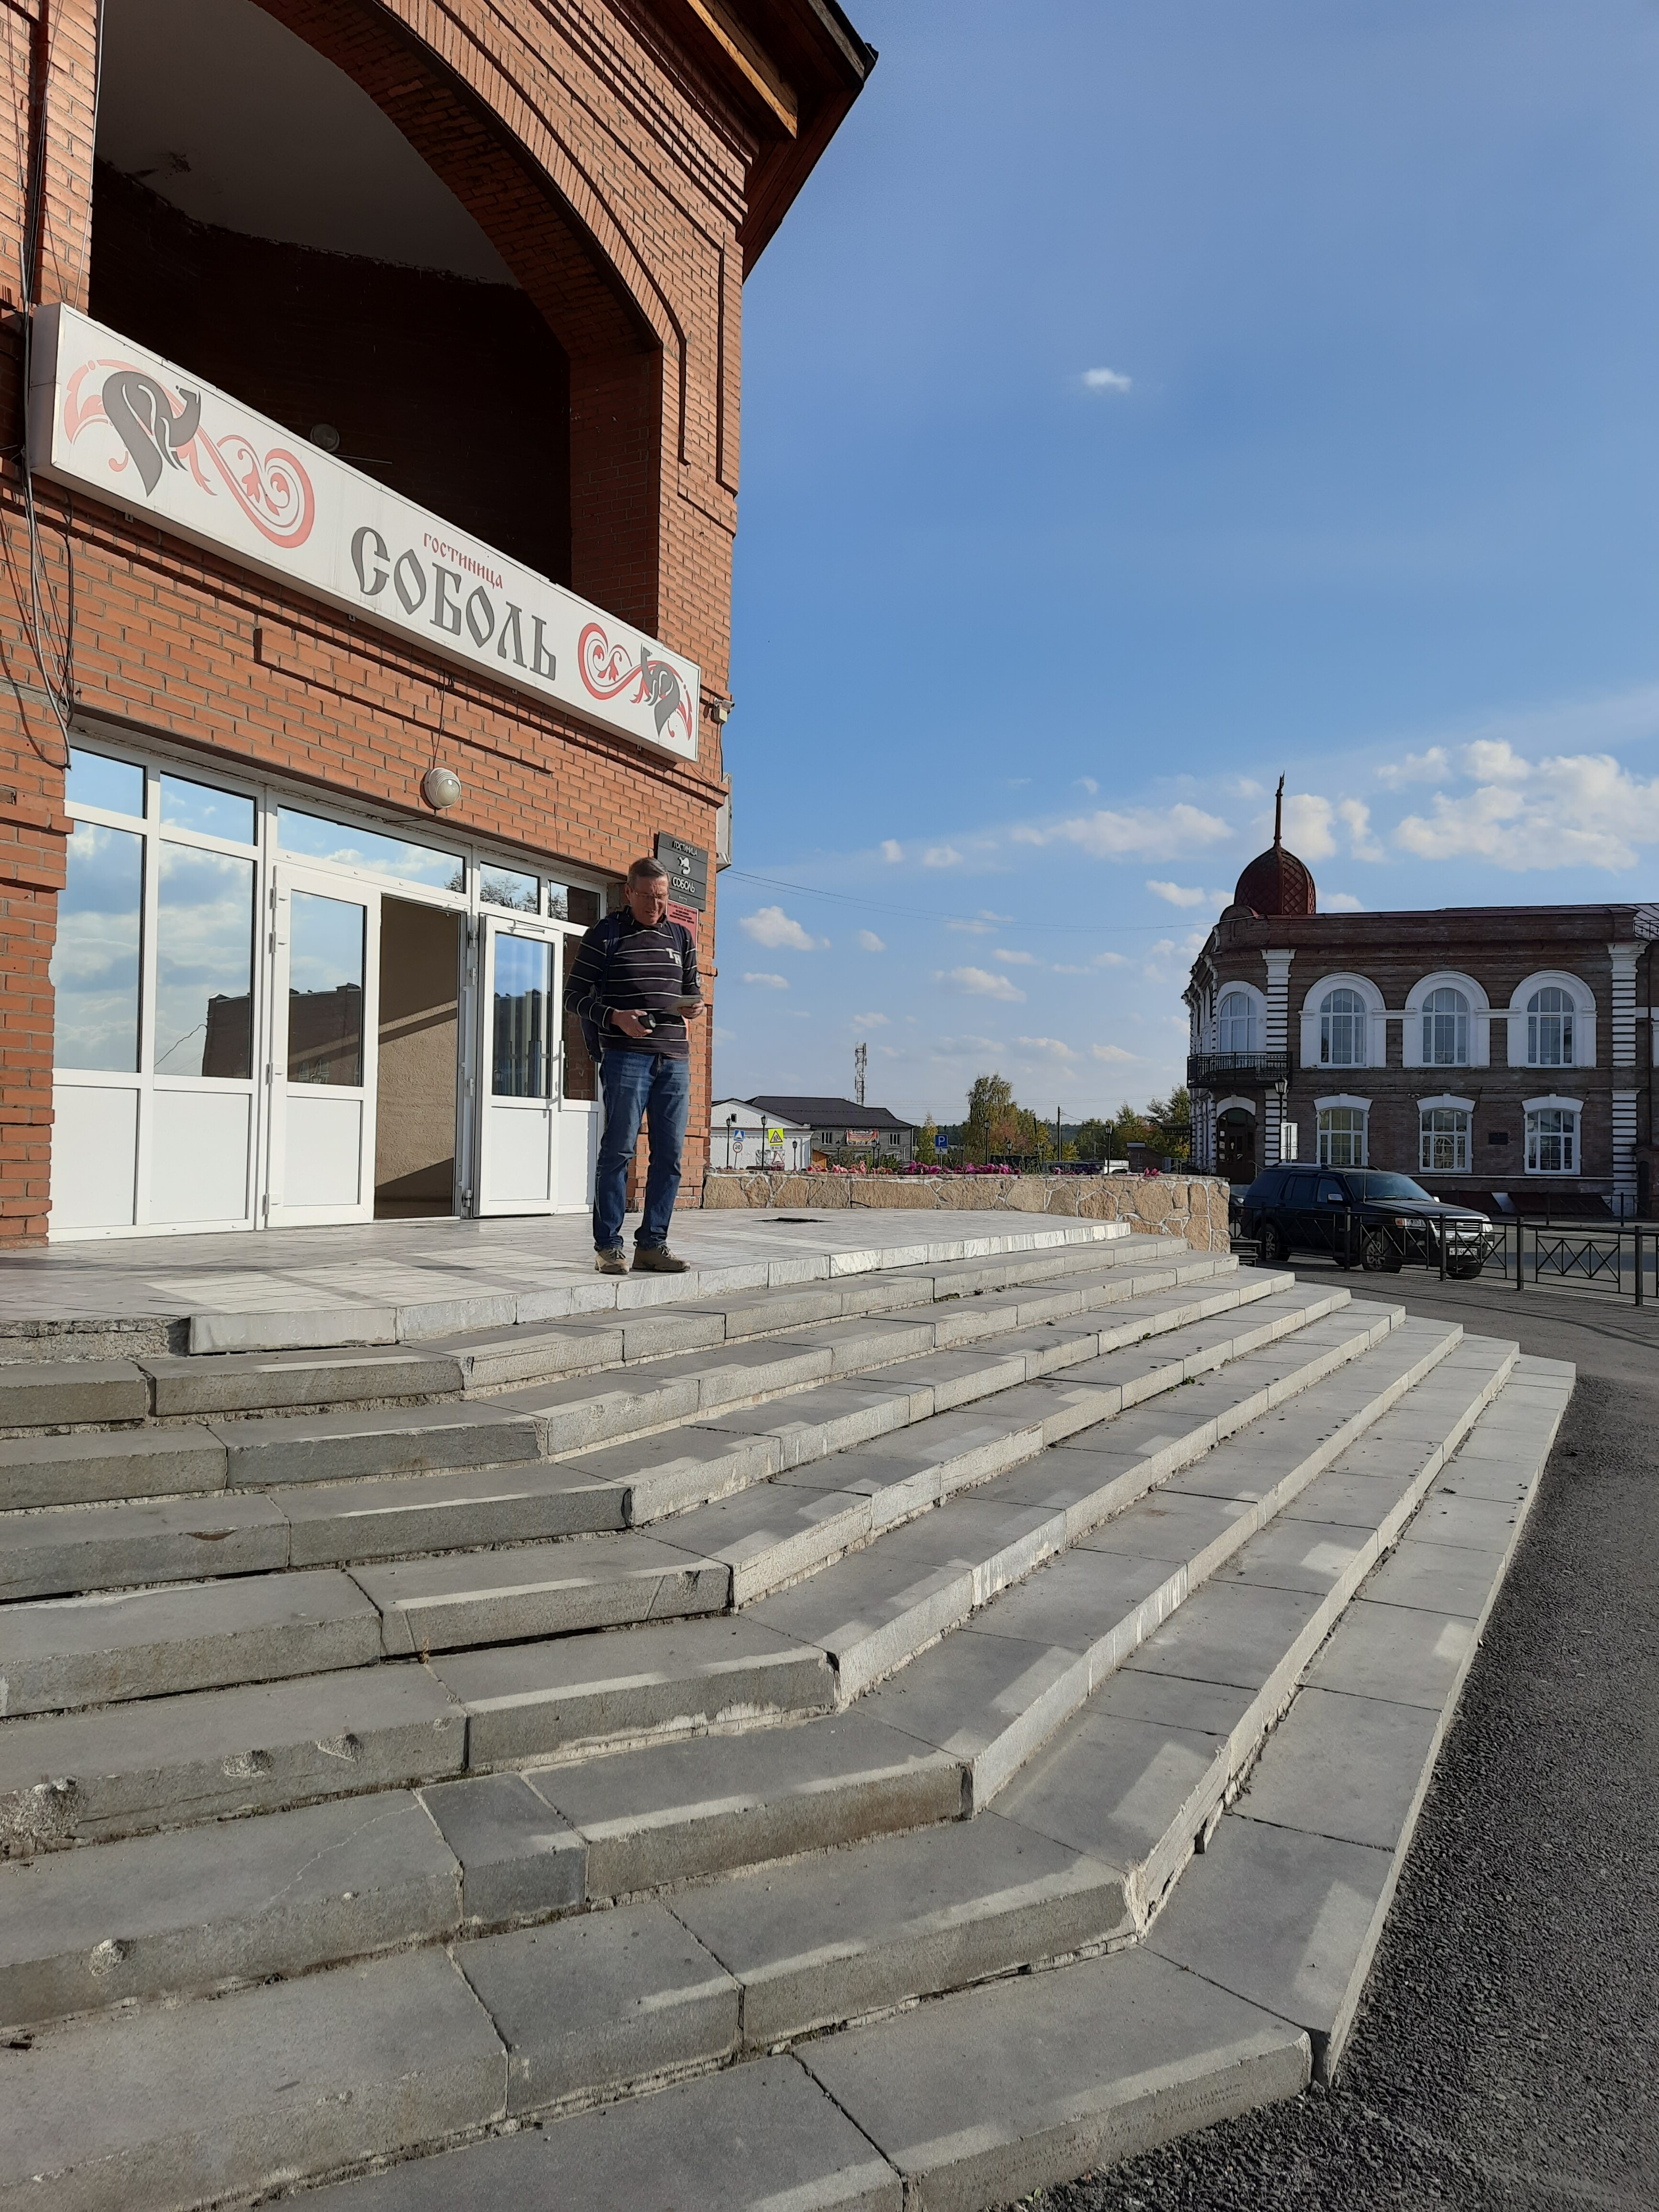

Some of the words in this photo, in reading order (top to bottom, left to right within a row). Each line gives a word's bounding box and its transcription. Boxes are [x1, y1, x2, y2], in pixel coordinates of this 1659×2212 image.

[424, 532, 503, 589] ГОСТИНИЦА
[351, 526, 556, 681] СОБОЛЬ
[674, 841, 697, 856] ГОСТИНИЦА
[673, 876, 695, 893] СОБОЛЬ
[938, 1136, 945, 1146] P
